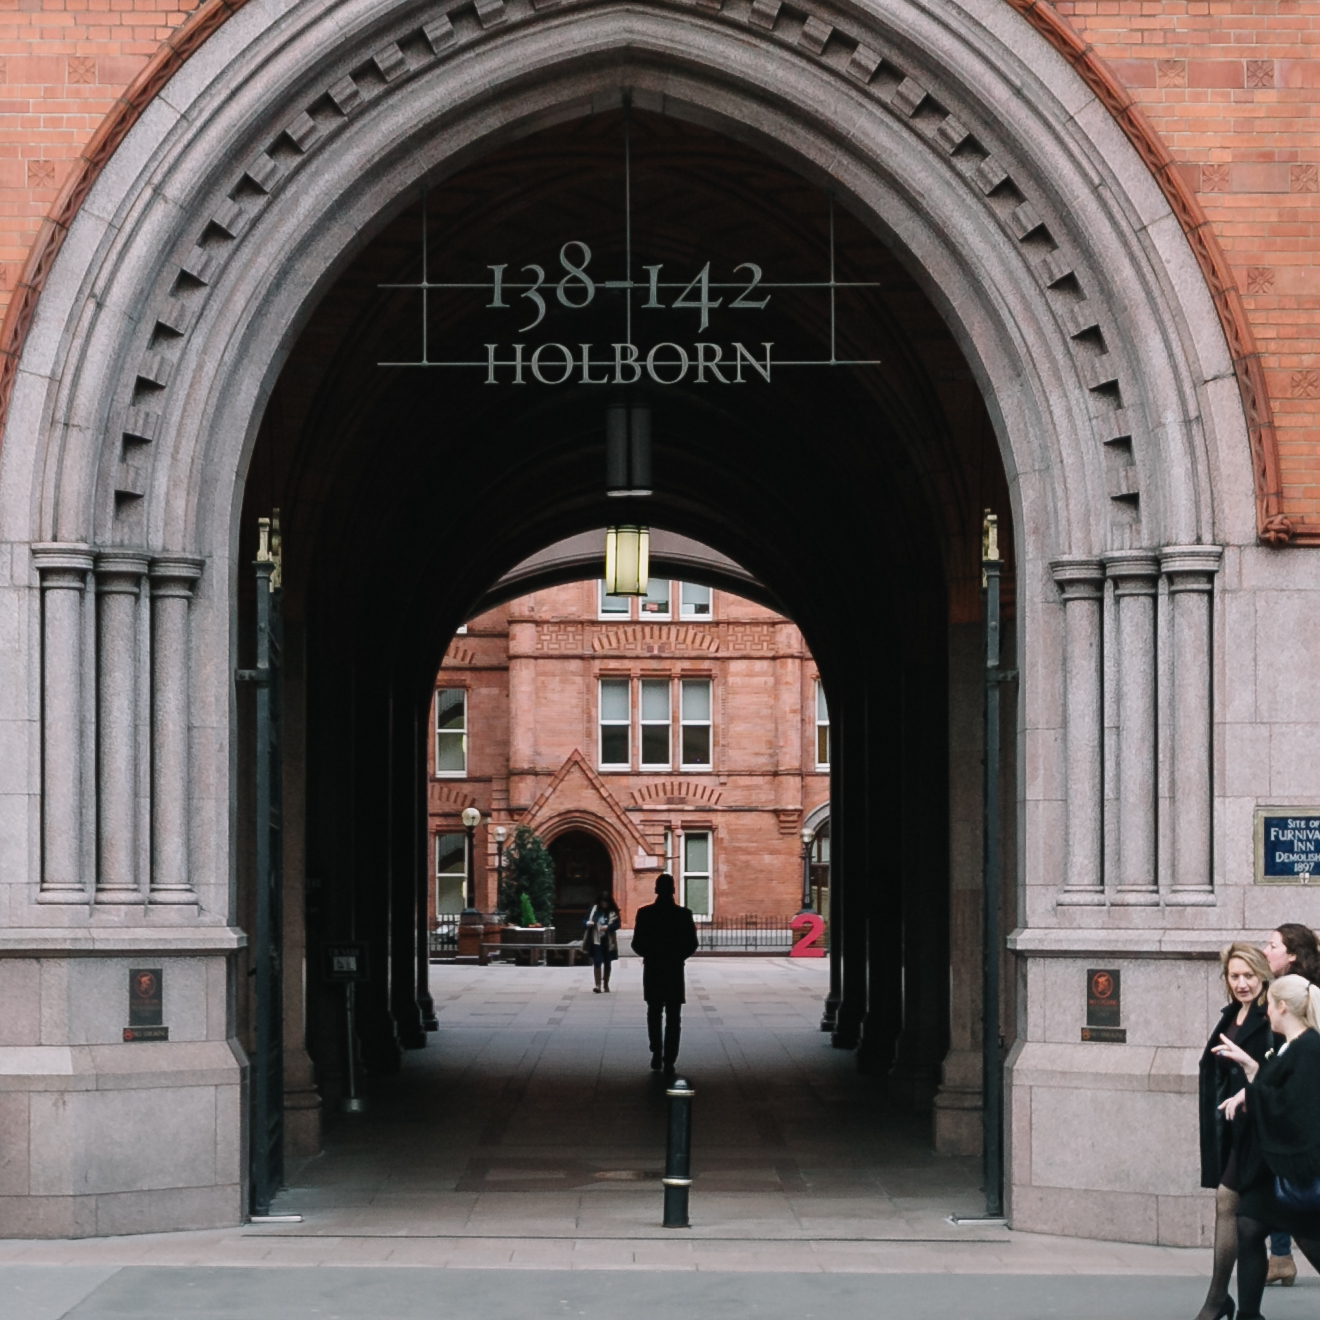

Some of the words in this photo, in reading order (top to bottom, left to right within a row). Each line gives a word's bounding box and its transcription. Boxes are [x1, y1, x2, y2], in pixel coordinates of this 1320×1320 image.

[485, 240, 772, 333] 138-142
[484, 342, 775, 385] HOLBORN
[1294, 840, 1315, 852] INN
[1294, 862, 1315, 872] 1897
[790, 913, 825, 956] 2
